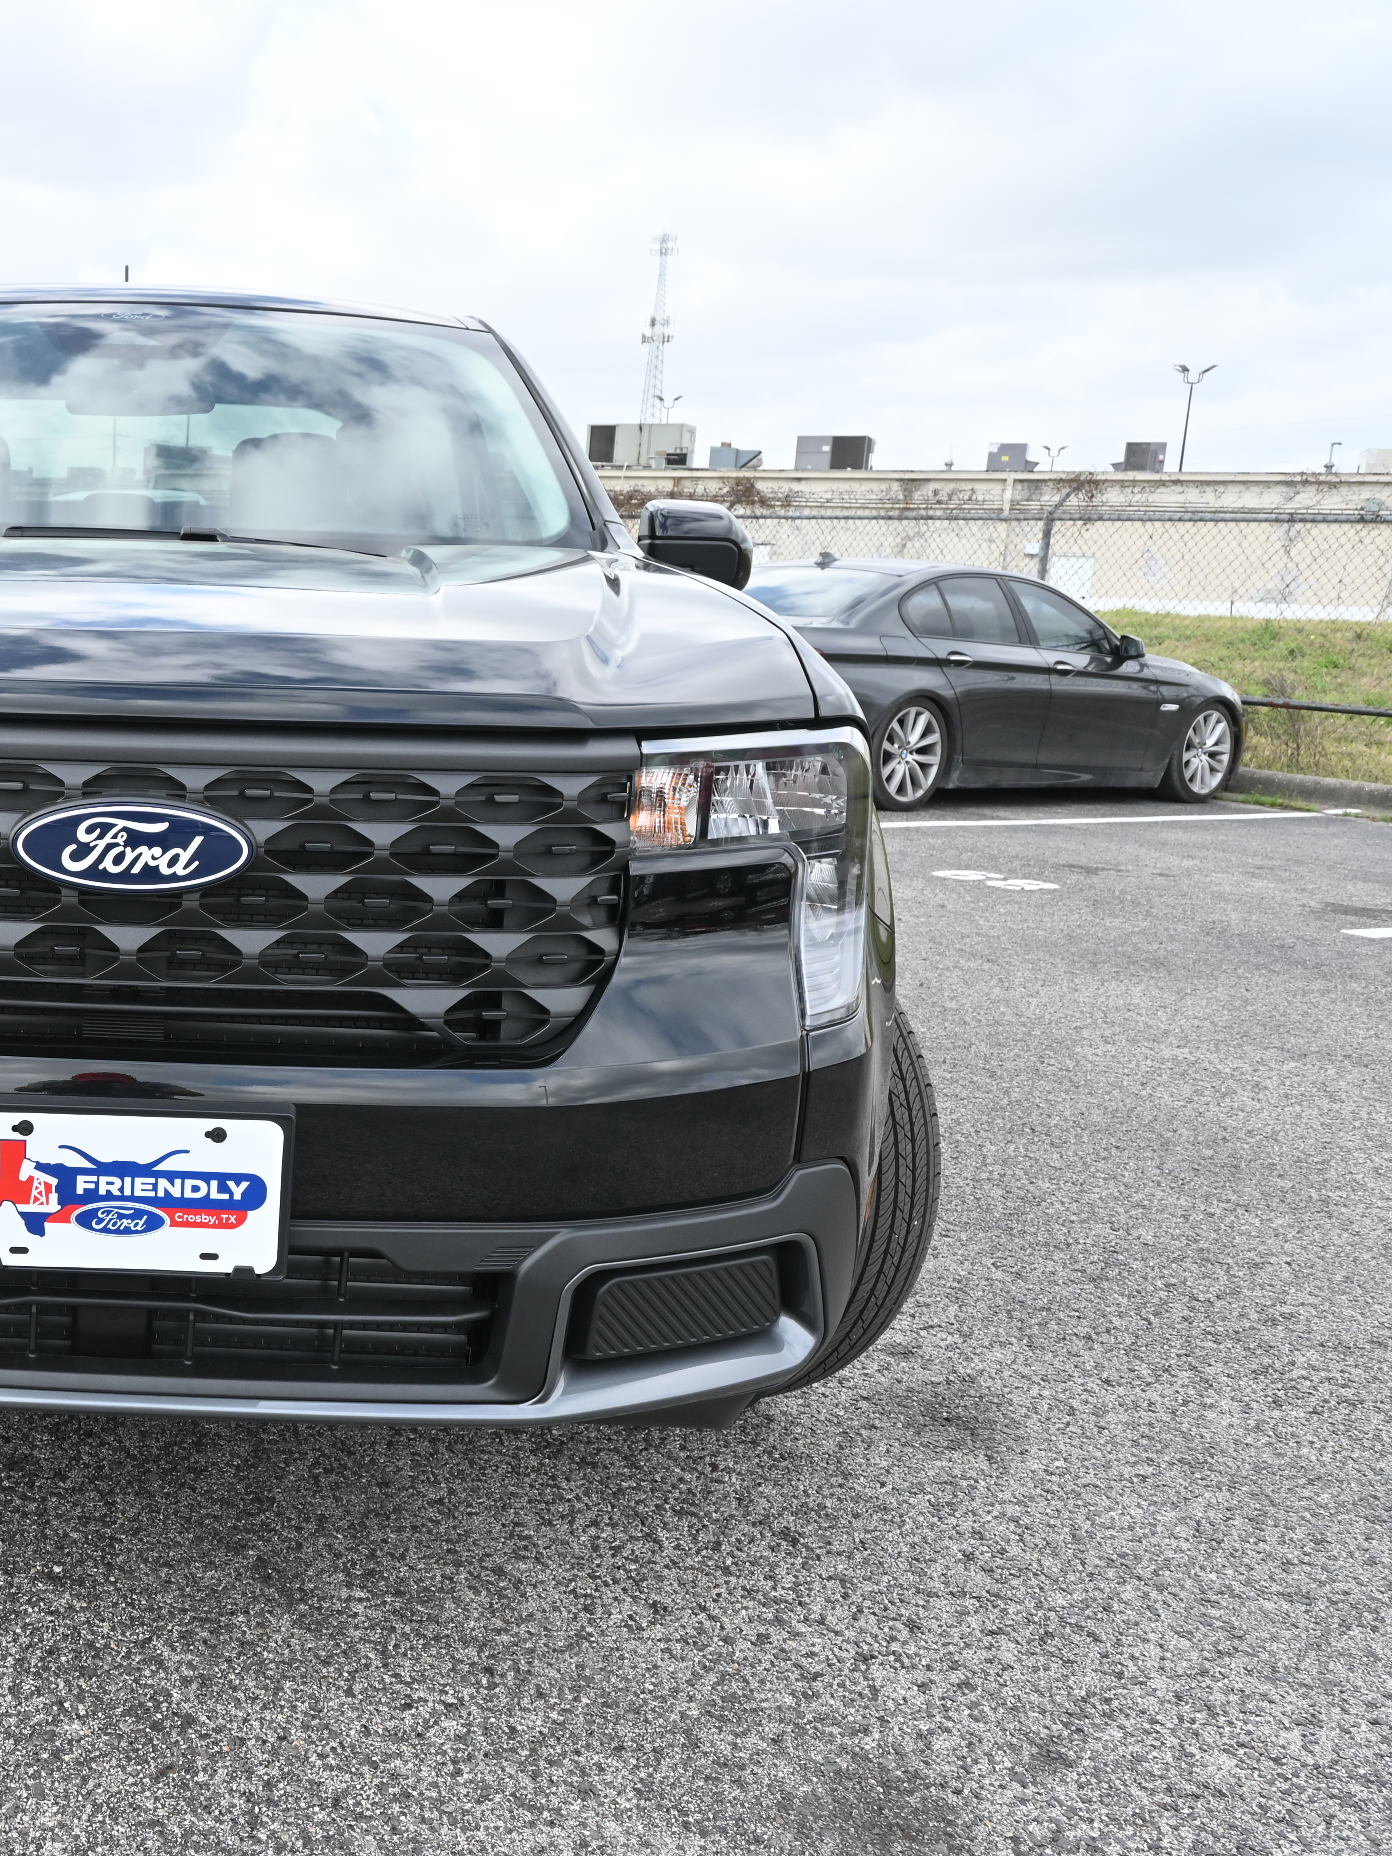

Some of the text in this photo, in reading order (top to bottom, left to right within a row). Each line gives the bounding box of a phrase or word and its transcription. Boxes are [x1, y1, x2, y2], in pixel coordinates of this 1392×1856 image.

[61, 816, 205, 876] Ford
[75, 1174, 251, 1201] FRIENDLY
[91, 1207, 148, 1232] Ford
[174, 1211, 237, 1225] Crosby, TX
